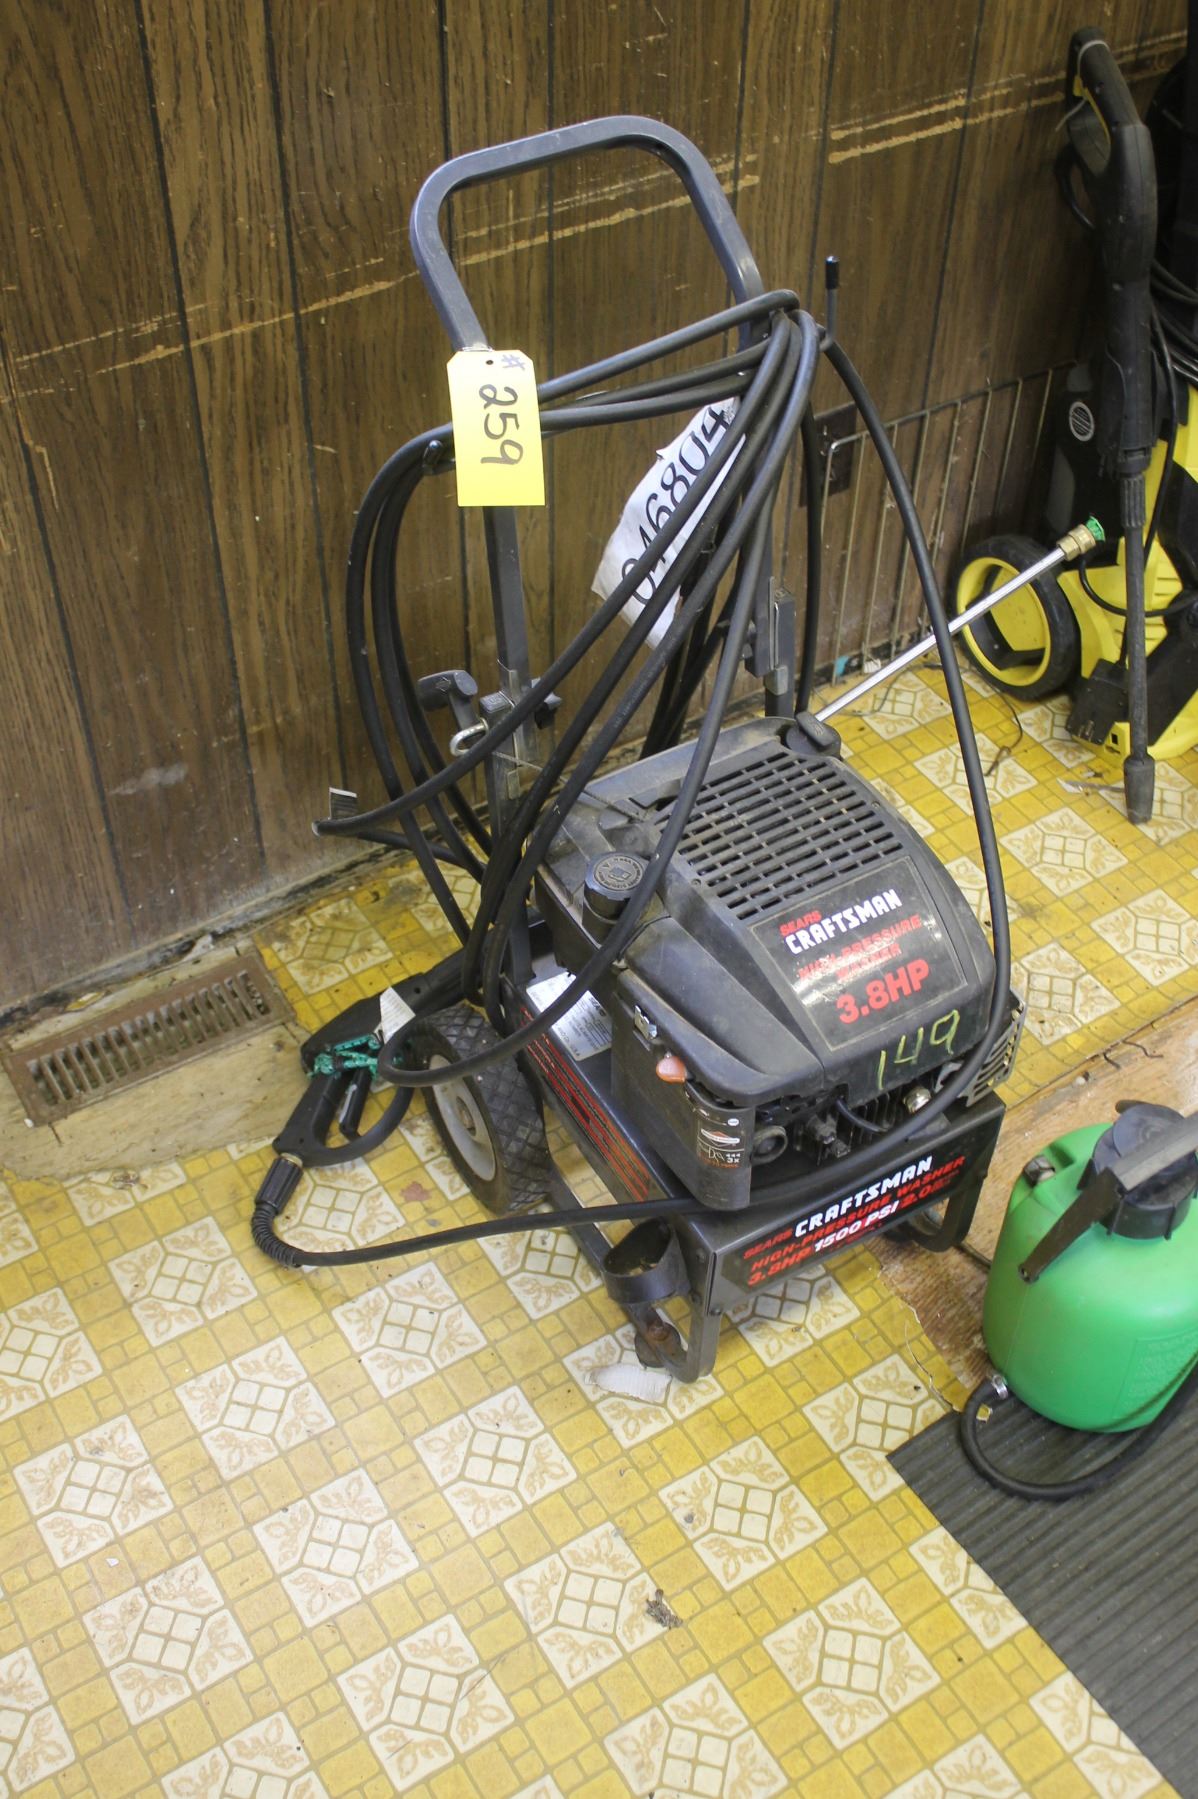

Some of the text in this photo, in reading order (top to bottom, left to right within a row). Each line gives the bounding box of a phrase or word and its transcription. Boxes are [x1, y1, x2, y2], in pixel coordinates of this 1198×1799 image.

[779, 910, 822, 936] SEARS
[785, 889, 902, 954] CRAFTSMAN
[836, 959, 929, 1024] 3.8HP
[877, 1009, 960, 1090] 149
[743, 1228, 793, 1260] SEARS
[795, 1155, 933, 1238] CRAFTSMAN
[897, 1155, 966, 1199] WASHER
[814, 1220, 862, 1252] 1500
[864, 1200, 900, 1227] PSI
